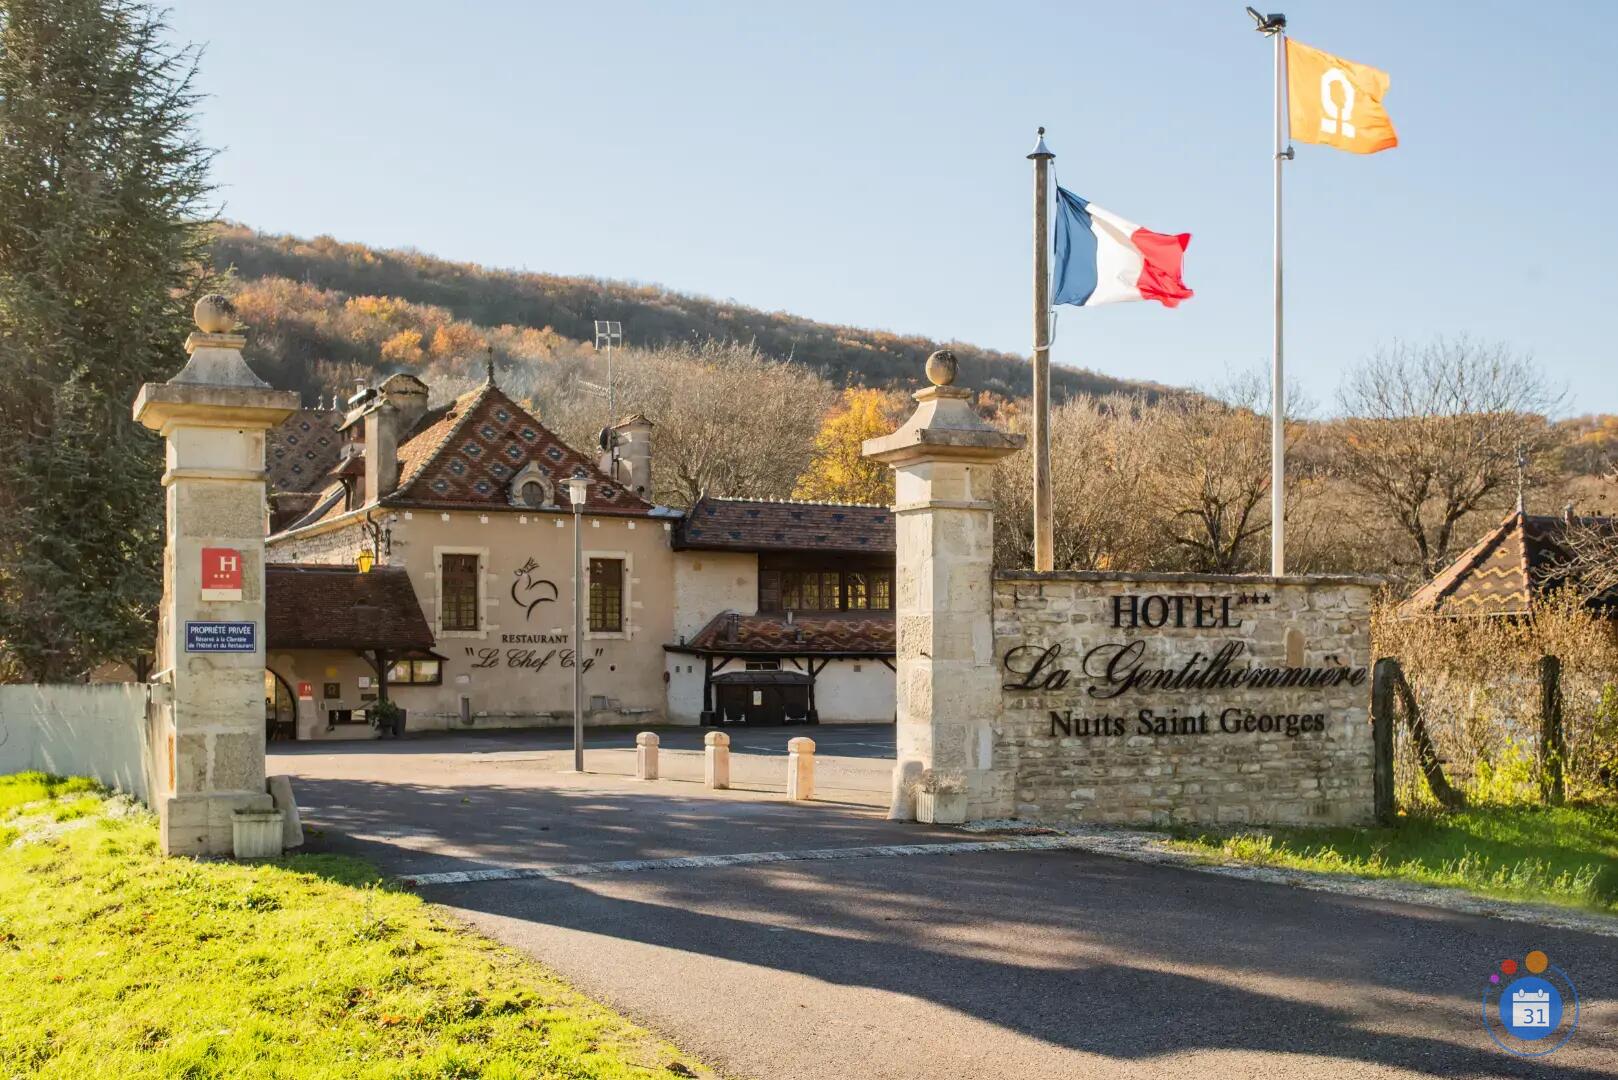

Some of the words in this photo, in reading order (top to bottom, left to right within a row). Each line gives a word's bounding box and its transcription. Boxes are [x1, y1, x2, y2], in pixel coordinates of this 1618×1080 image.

[220, 556, 236, 571] H
[1111, 595, 1244, 629] HOTEL
[190, 624, 226, 634] PROPRIÉTÉ
[228, 625, 251, 635] PRIVÉE
[502, 634, 568, 644] RESTAURANT
[506, 648, 556, 672] Chef
[1002, 643, 1071, 691] La
[1050, 710, 1126, 737] Nuits
[1137, 709, 1209, 736] Saint
[1219, 708, 1325, 737] Georges
